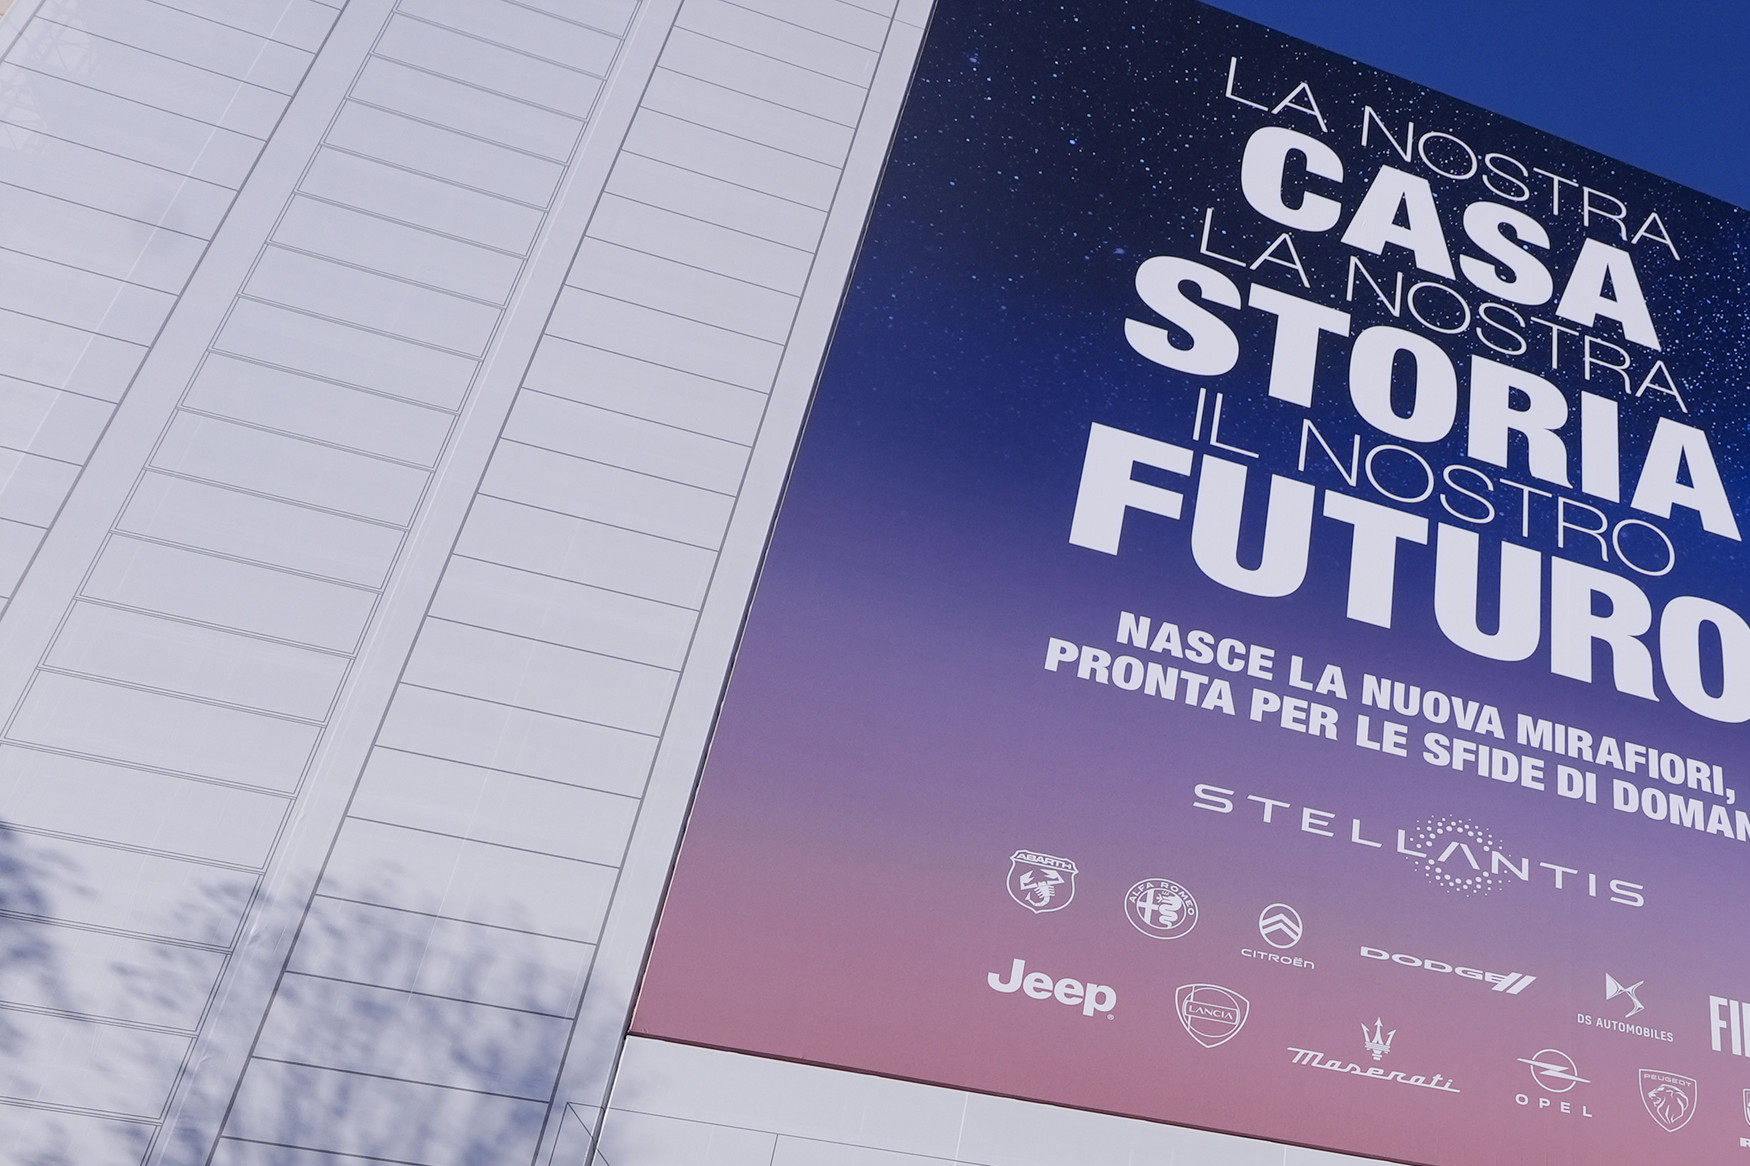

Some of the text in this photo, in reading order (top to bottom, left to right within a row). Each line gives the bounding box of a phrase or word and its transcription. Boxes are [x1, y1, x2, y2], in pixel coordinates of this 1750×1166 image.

[1225, 56, 1680, 261] LA NOSTRA
[1241, 126, 1662, 352] CASA
[1200, 207, 1689, 414] LA NOSTRA
[1124, 256, 1742, 542] STORIA
[1192, 387, 1676, 577] IL NOSTRO
[1044, 637, 1236, 716] PRONTA
[1249, 687, 1339, 741] PER
[1356, 714, 1409, 758] LE
[1422, 732, 1545, 792] SFIDE
[1557, 764, 1597, 804] DI
[1116, 610, 1736, 805] NASCE LA NUOVA MIRAFIORI,
[1016, 852, 1073, 871] ABARTH
[1192, 783, 1646, 907] STELLANTIS
[1129, 881, 1195, 916] ALFA ROMEO
[987, 958, 1117, 1017] Jeep
[1360, 946, 1509, 985] DODGE
[1188, 1004, 1234, 1020] LANCIA
[1577, 1013, 1674, 1043] DS AUTOMOBILES
[1286, 1046, 1461, 1093] Maserati
[1643, 1073, 1692, 1088] PEUGEOT
[1515, 1093, 1593, 1118] OPEL
